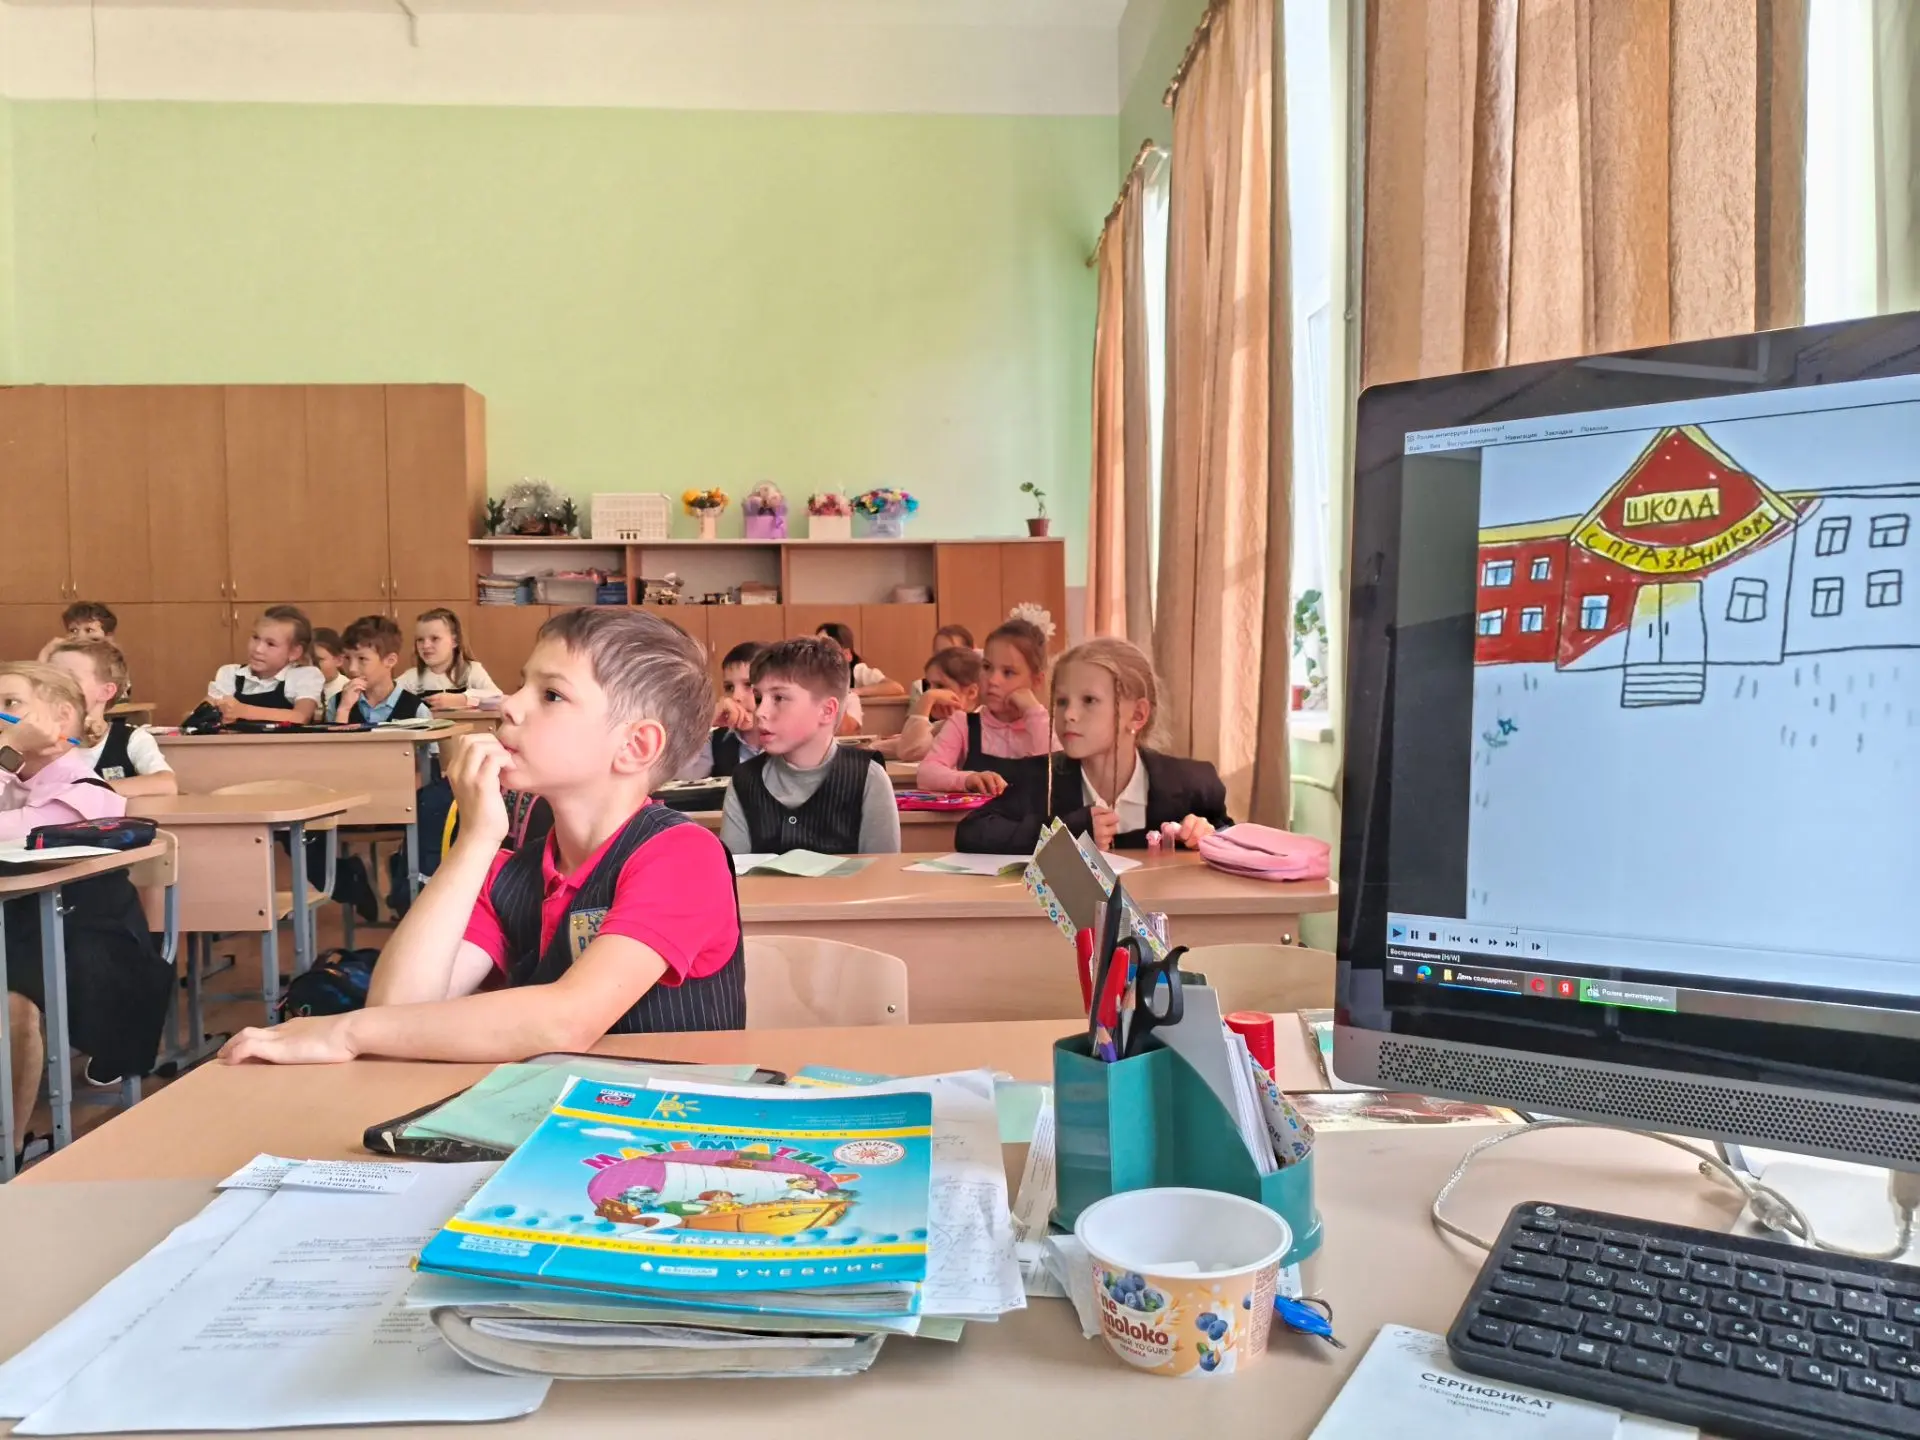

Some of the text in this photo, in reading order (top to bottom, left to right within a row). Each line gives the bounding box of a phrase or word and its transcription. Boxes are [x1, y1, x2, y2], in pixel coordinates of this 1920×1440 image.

[1627, 493, 1716, 523] ШКОЛА
[1585, 511, 1775, 569] С ПРАЗДНИКОМ
[580, 1138, 861, 1185] МАТЕМАТИКА
[621, 1212, 683, 1242] 2
[735, 1261, 885, 1279] УЧЕБНИК
[1586, 1269, 1596, 1277] Q
[1630, 1278, 1644, 1286] W
[1679, 1287, 1688, 1295] E
[1636, 1303, 1644, 1311] S
[1684, 1313, 1694, 1321] D
[1102, 1309, 1169, 1346] moloko
[1603, 1322, 1613, 1330] Z
[1884, 1326, 1896, 1336] U
[1651, 1332, 1662, 1341] X
[1786, 1334, 1798, 1343] G
[1701, 1343, 1715, 1352] C
[1841, 1344, 1852, 1353] H
[1755, 1353, 1767, 1363] V
[1764, 1361, 1778, 1371] М
[1864, 1376, 1877, 1386] N
[1420, 1372, 1554, 1410] СЕРТИФИКАТ
